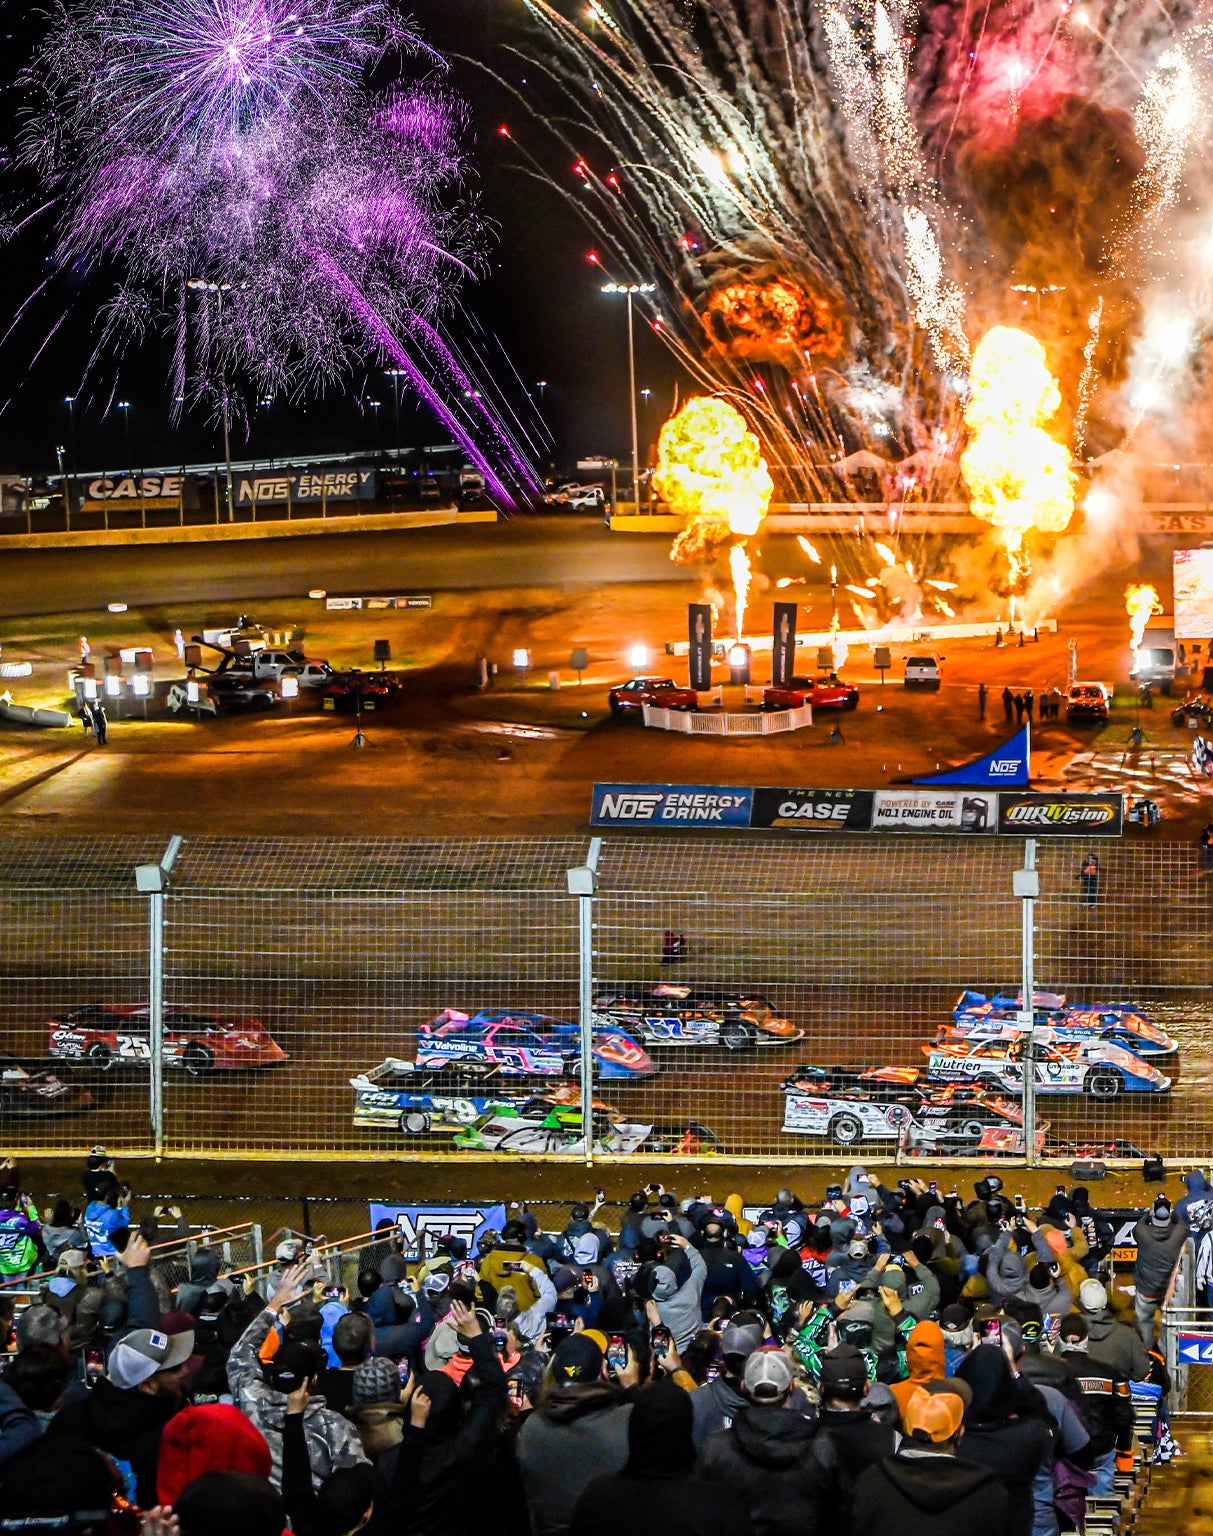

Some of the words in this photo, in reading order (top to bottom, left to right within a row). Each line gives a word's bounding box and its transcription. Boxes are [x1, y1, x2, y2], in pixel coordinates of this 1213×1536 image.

[88, 476, 184, 498] CASE
[300, 472, 371, 487] ENERGY
[239, 476, 291, 501] NOS
[297, 485, 353, 498] DRINK
[989, 760, 1021, 773] NOS
[599, 793, 662, 819] NOS
[665, 794, 746, 808] ENERGY
[662, 807, 724, 821] DRINK
[778, 802, 851, 819] CASE
[878, 808, 899, 817] NO.1
[901, 809, 936, 818] ENGINE
[938, 809, 954, 819] OIL
[645, 1018, 685, 1038] 57
[115, 1036, 151, 1058] 25
[435, 1041, 478, 1053] Valvoline
[932, 1058, 981, 1071] Nutrien
[397, 1212, 479, 1249] NOS
